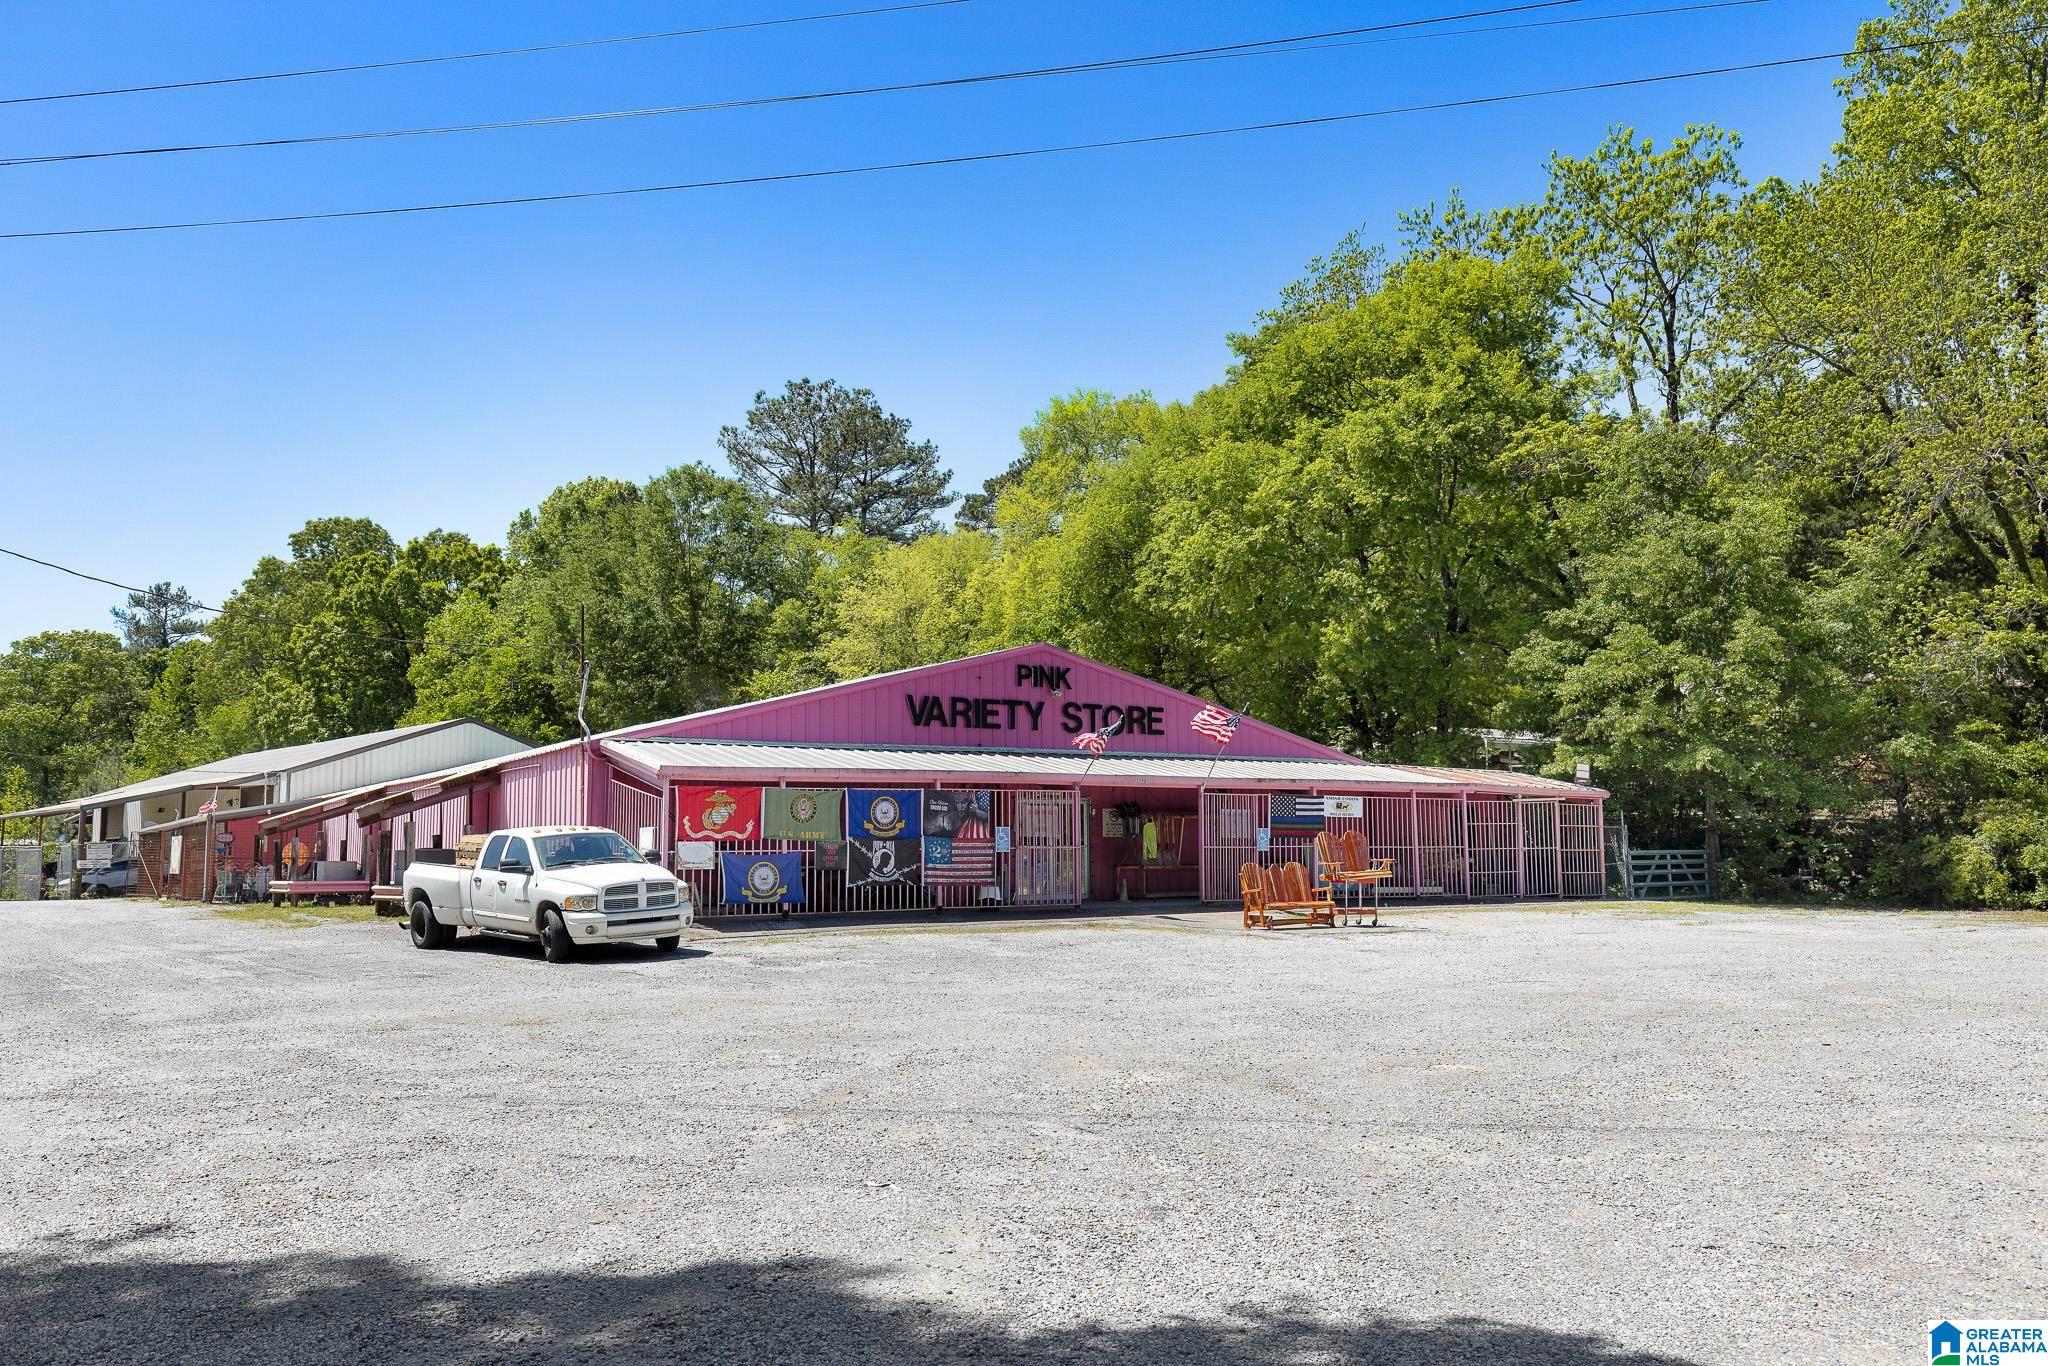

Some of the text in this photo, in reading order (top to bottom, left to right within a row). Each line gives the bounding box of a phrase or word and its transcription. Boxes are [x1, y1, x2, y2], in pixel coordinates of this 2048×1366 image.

[1016, 664, 1072, 690] PINK
[906, 694, 1165, 735] VARIETY STORE
[800, 831, 825, 839] ARMY
